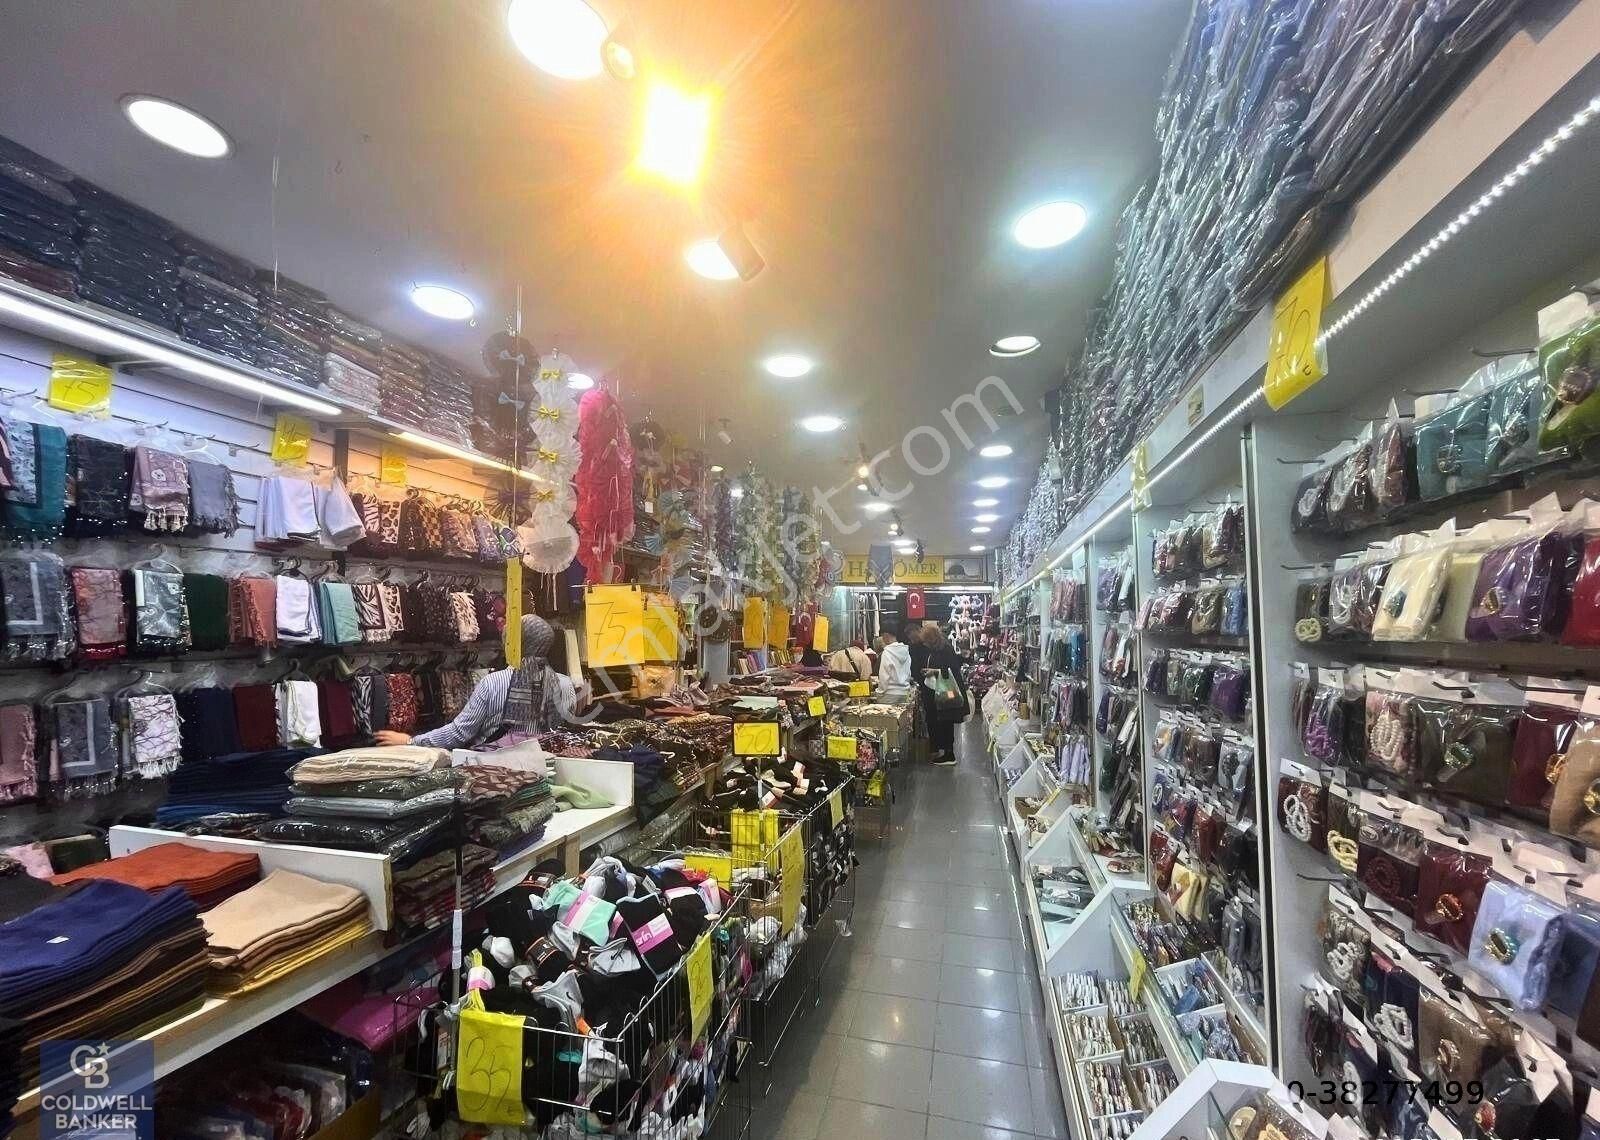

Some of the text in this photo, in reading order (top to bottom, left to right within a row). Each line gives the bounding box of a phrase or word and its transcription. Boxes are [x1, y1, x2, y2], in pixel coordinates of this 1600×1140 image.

[893, 557, 939, 578] ÖMER
[587, 601, 628, 657] 75
[464, 1036, 513, 1113] 35
